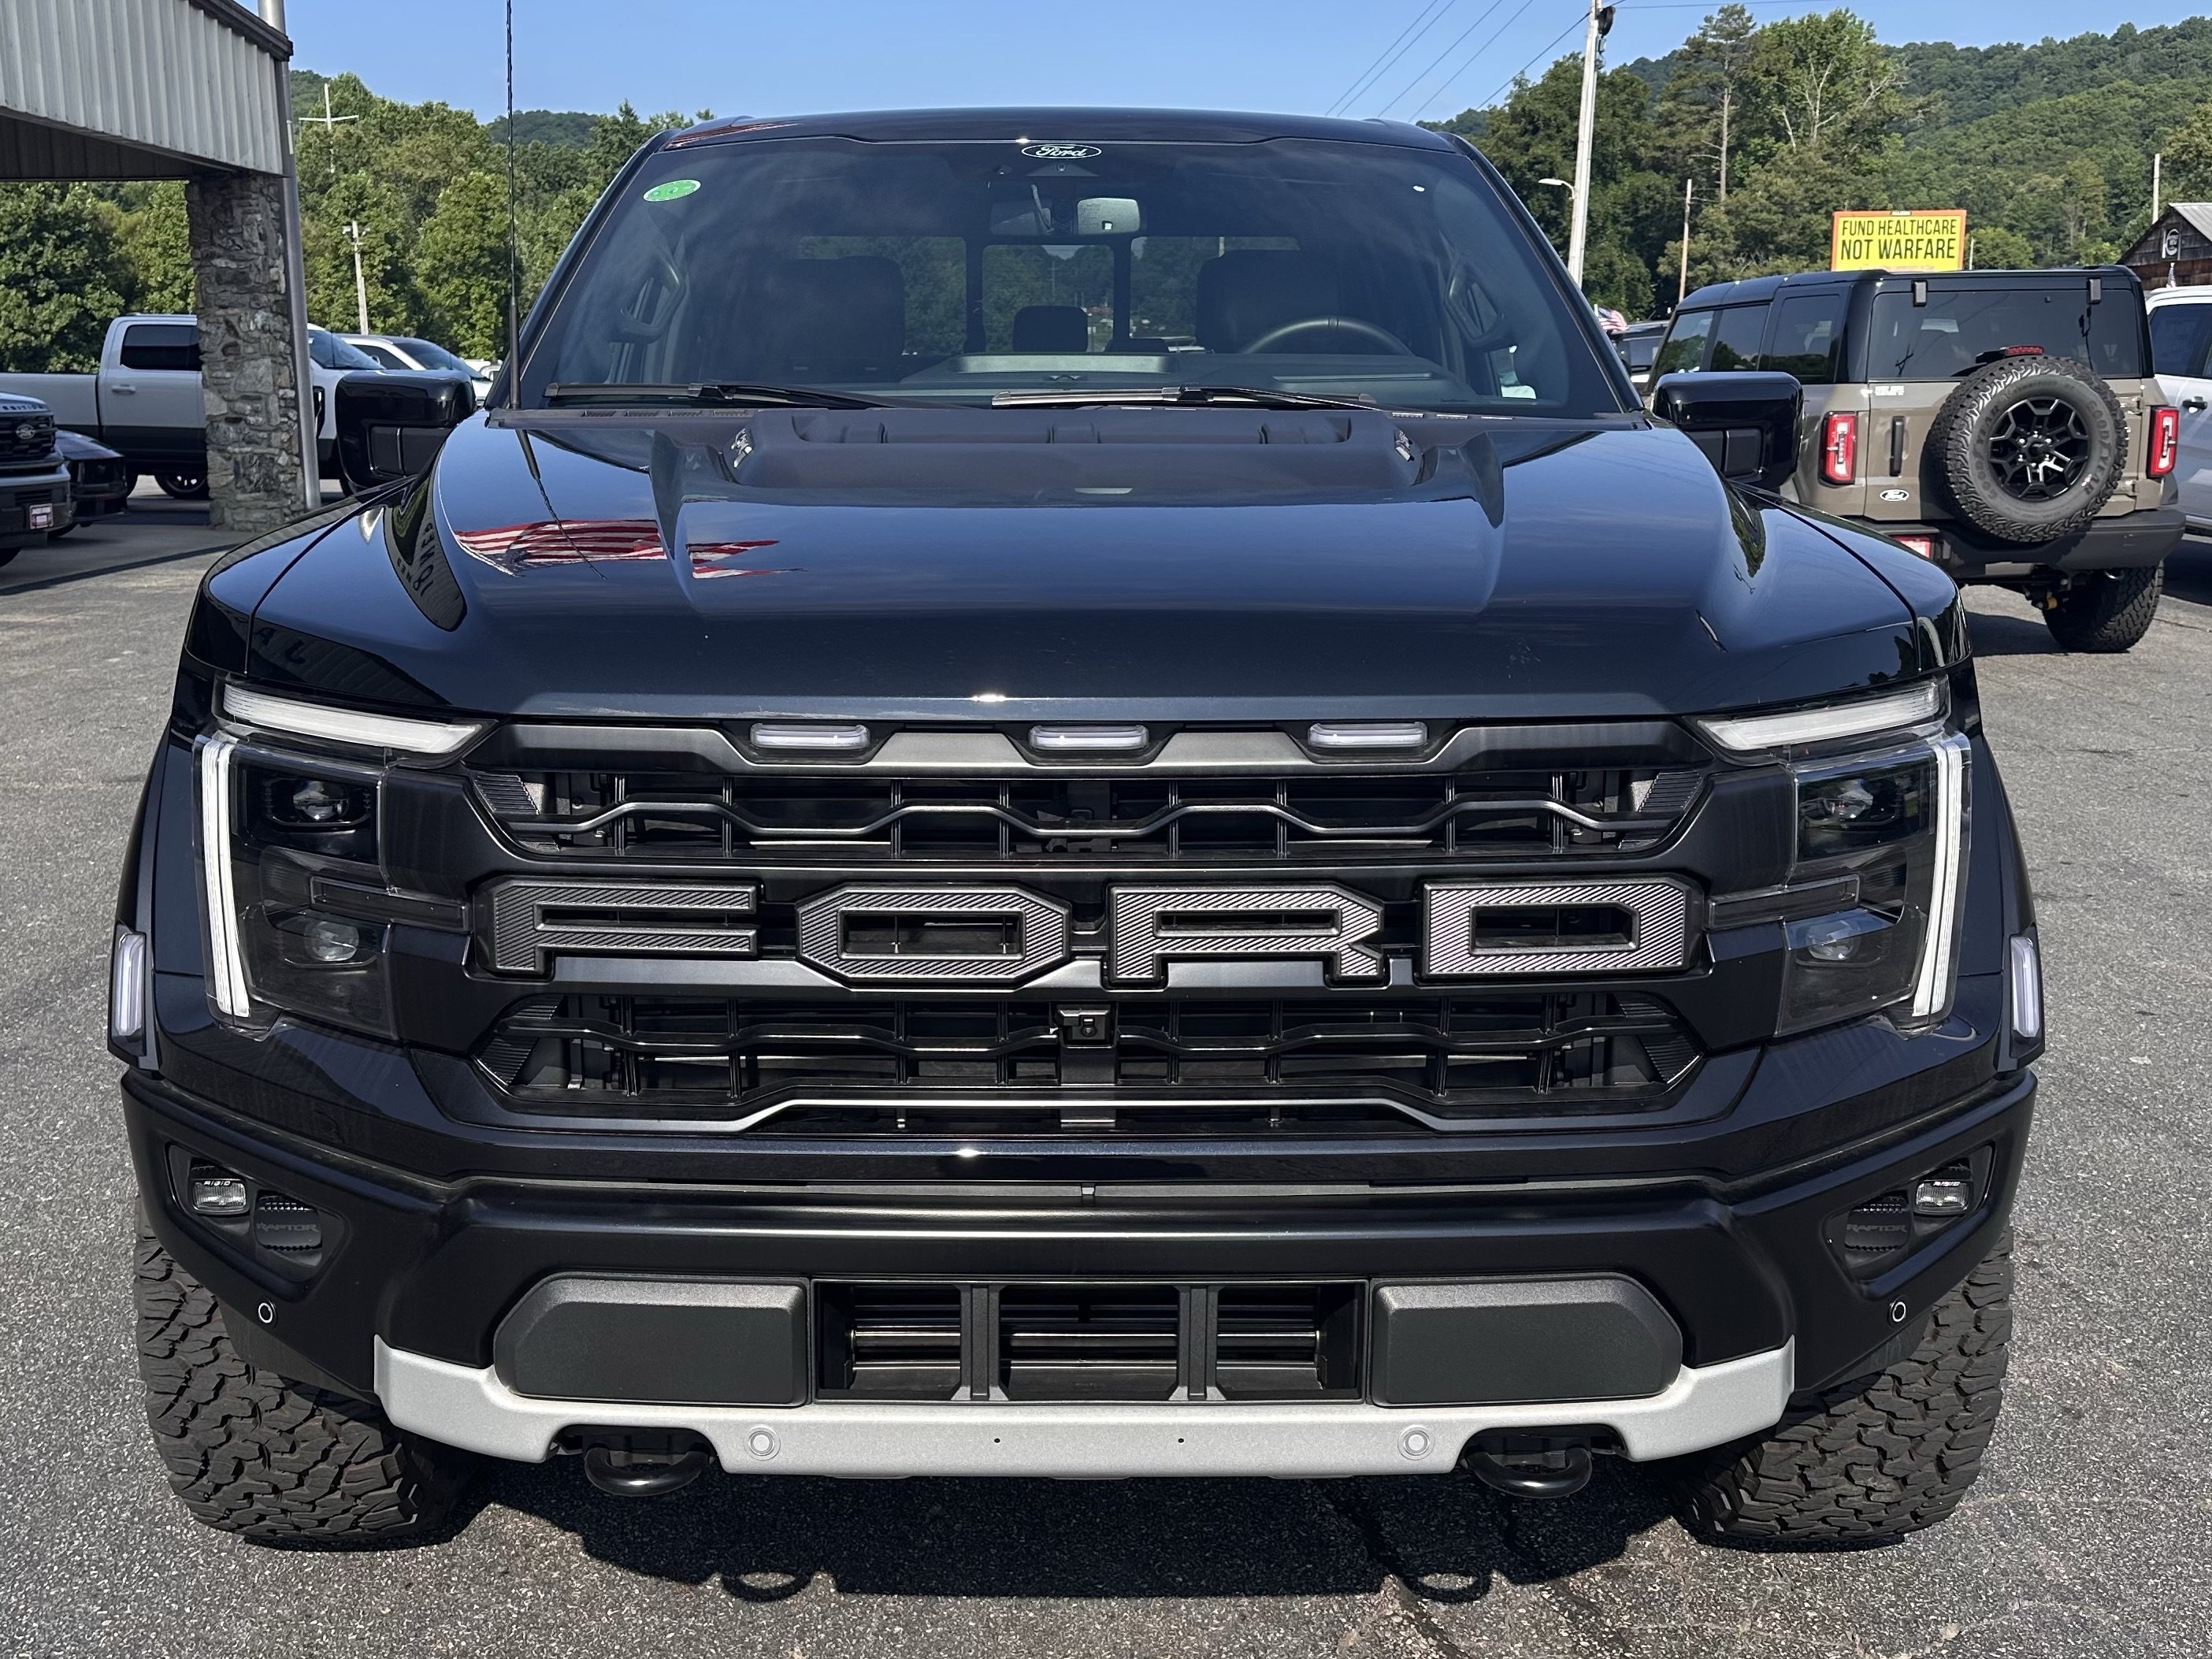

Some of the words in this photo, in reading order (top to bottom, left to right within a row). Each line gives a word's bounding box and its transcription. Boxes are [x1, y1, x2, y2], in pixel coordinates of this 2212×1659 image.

[1035, 145, 1089, 157] Ford
[1842, 220, 1874, 236] FUND
[1878, 219, 1957, 236] HEALTHCARE
[1840, 239, 1873, 260] NOT
[1878, 238, 1956, 259] WARFARE
[481, 876, 1695, 981] FORD
[257, 1223, 319, 1233] RAPTOR
[1846, 1223, 1908, 1233] RAPTOR
